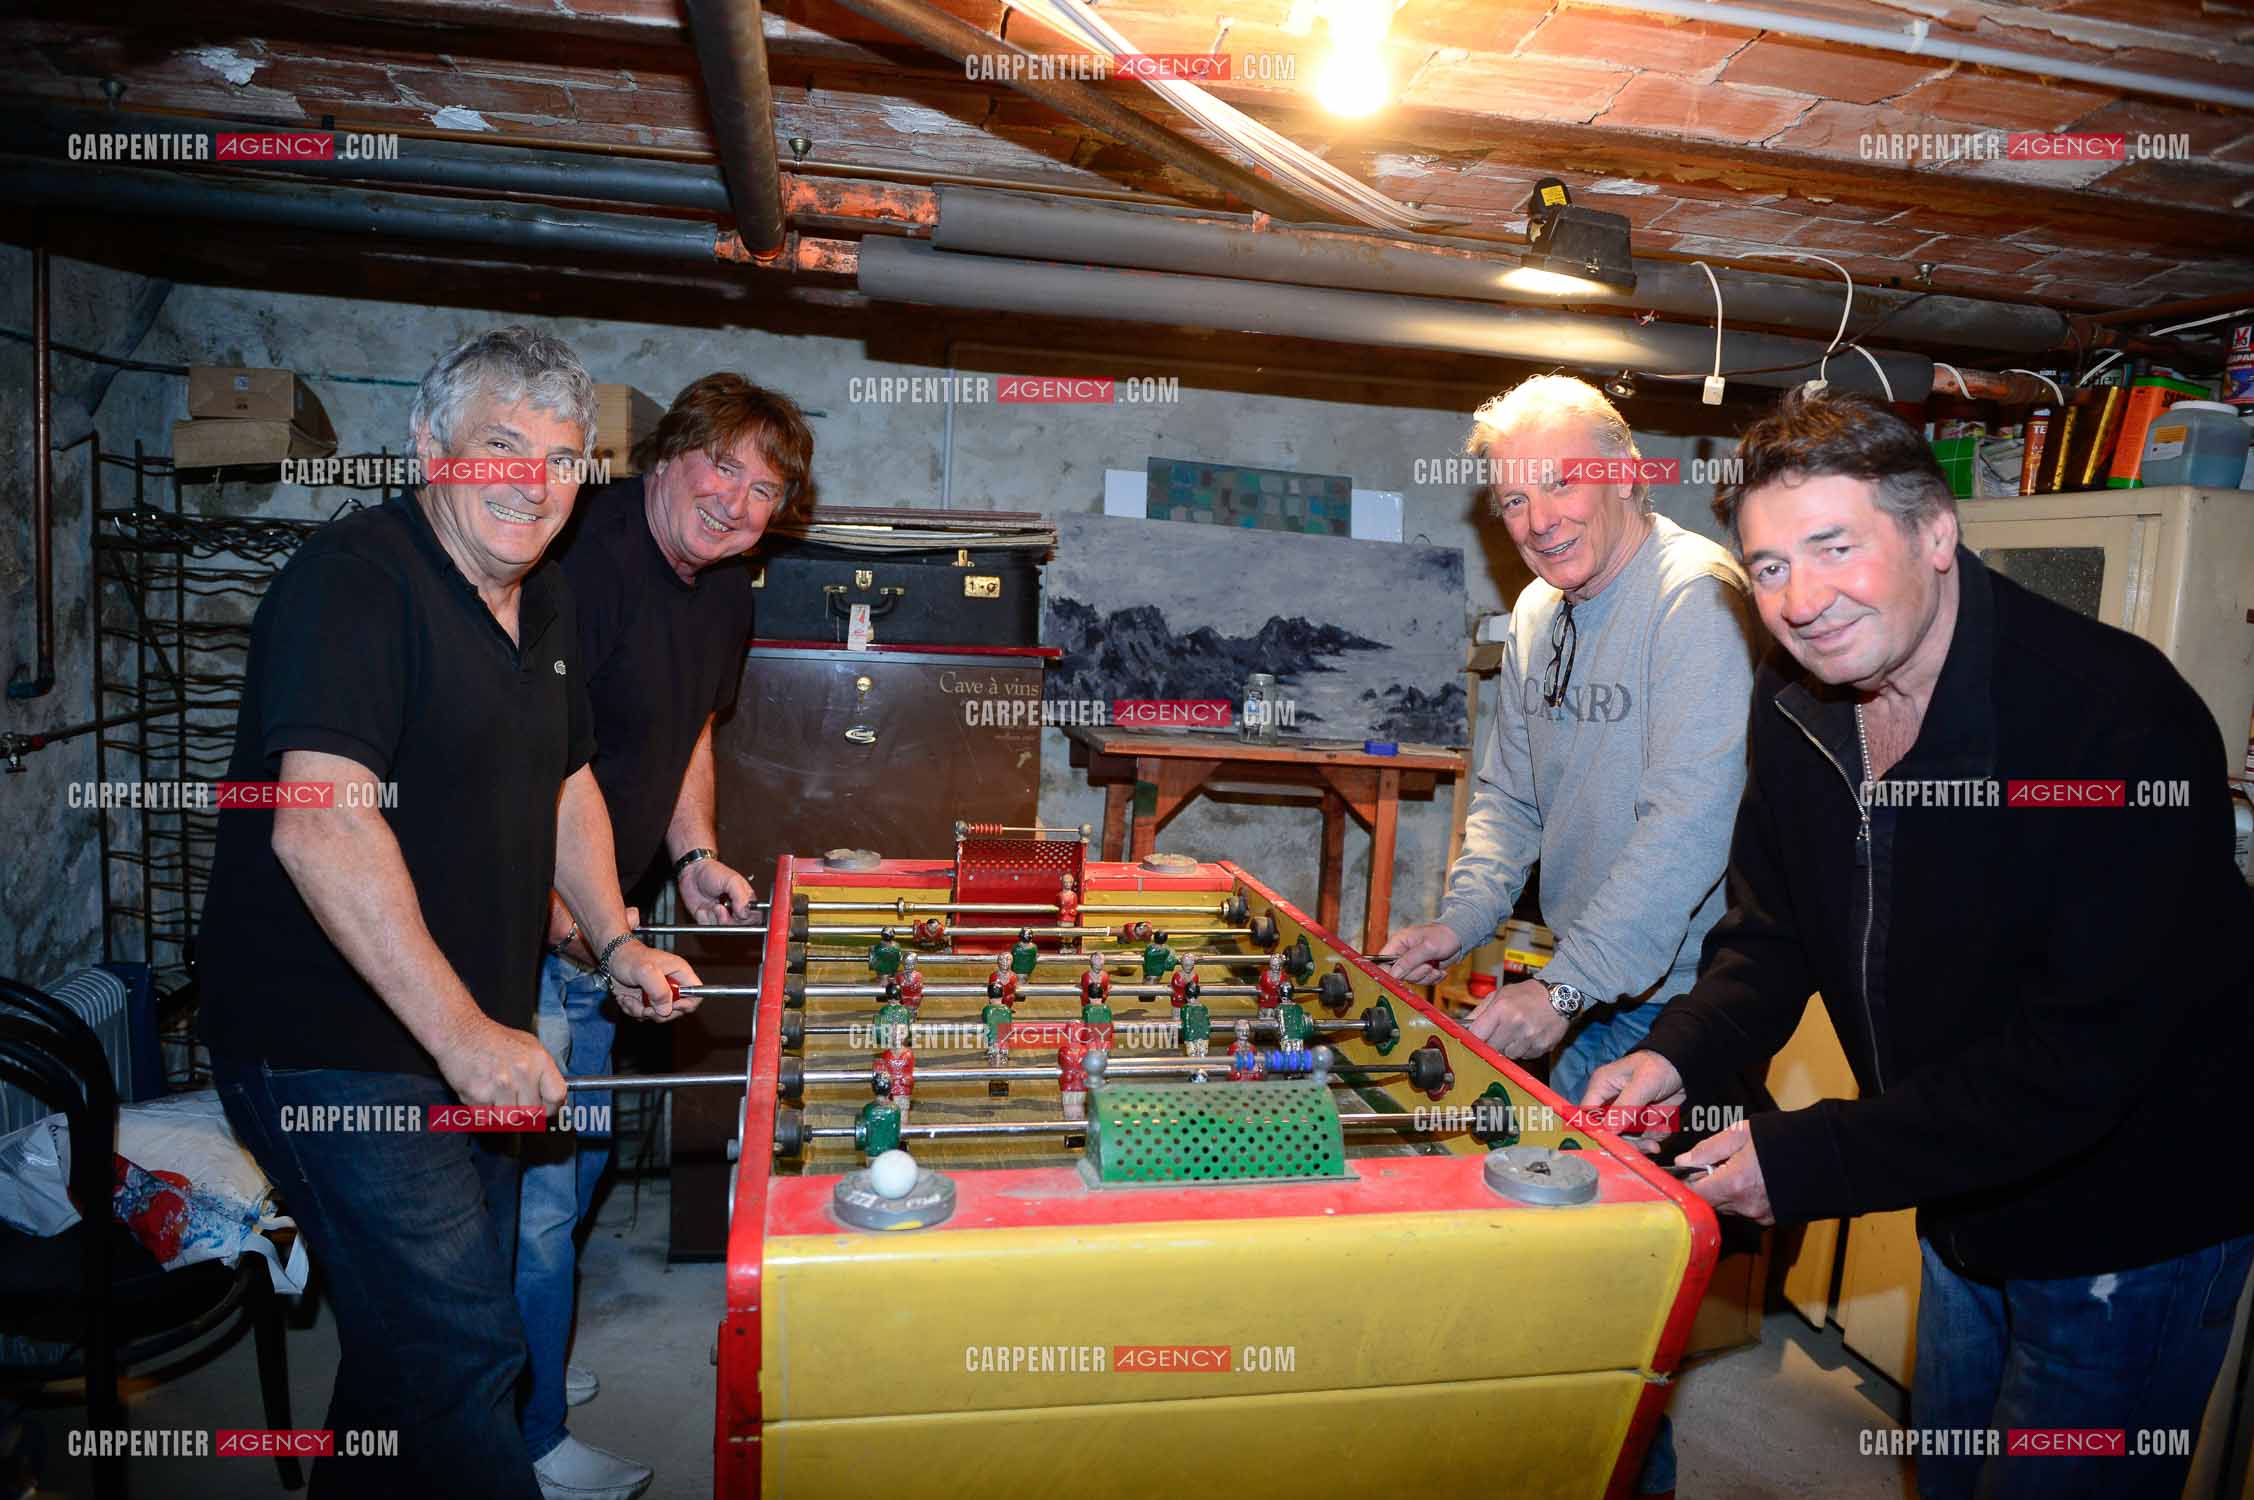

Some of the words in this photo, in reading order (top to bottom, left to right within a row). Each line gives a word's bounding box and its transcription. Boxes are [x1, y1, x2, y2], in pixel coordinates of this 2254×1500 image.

[939, 671, 984, 695] Cave
[988, 676, 999, 695] à
[1004, 678, 1041, 697] vins
